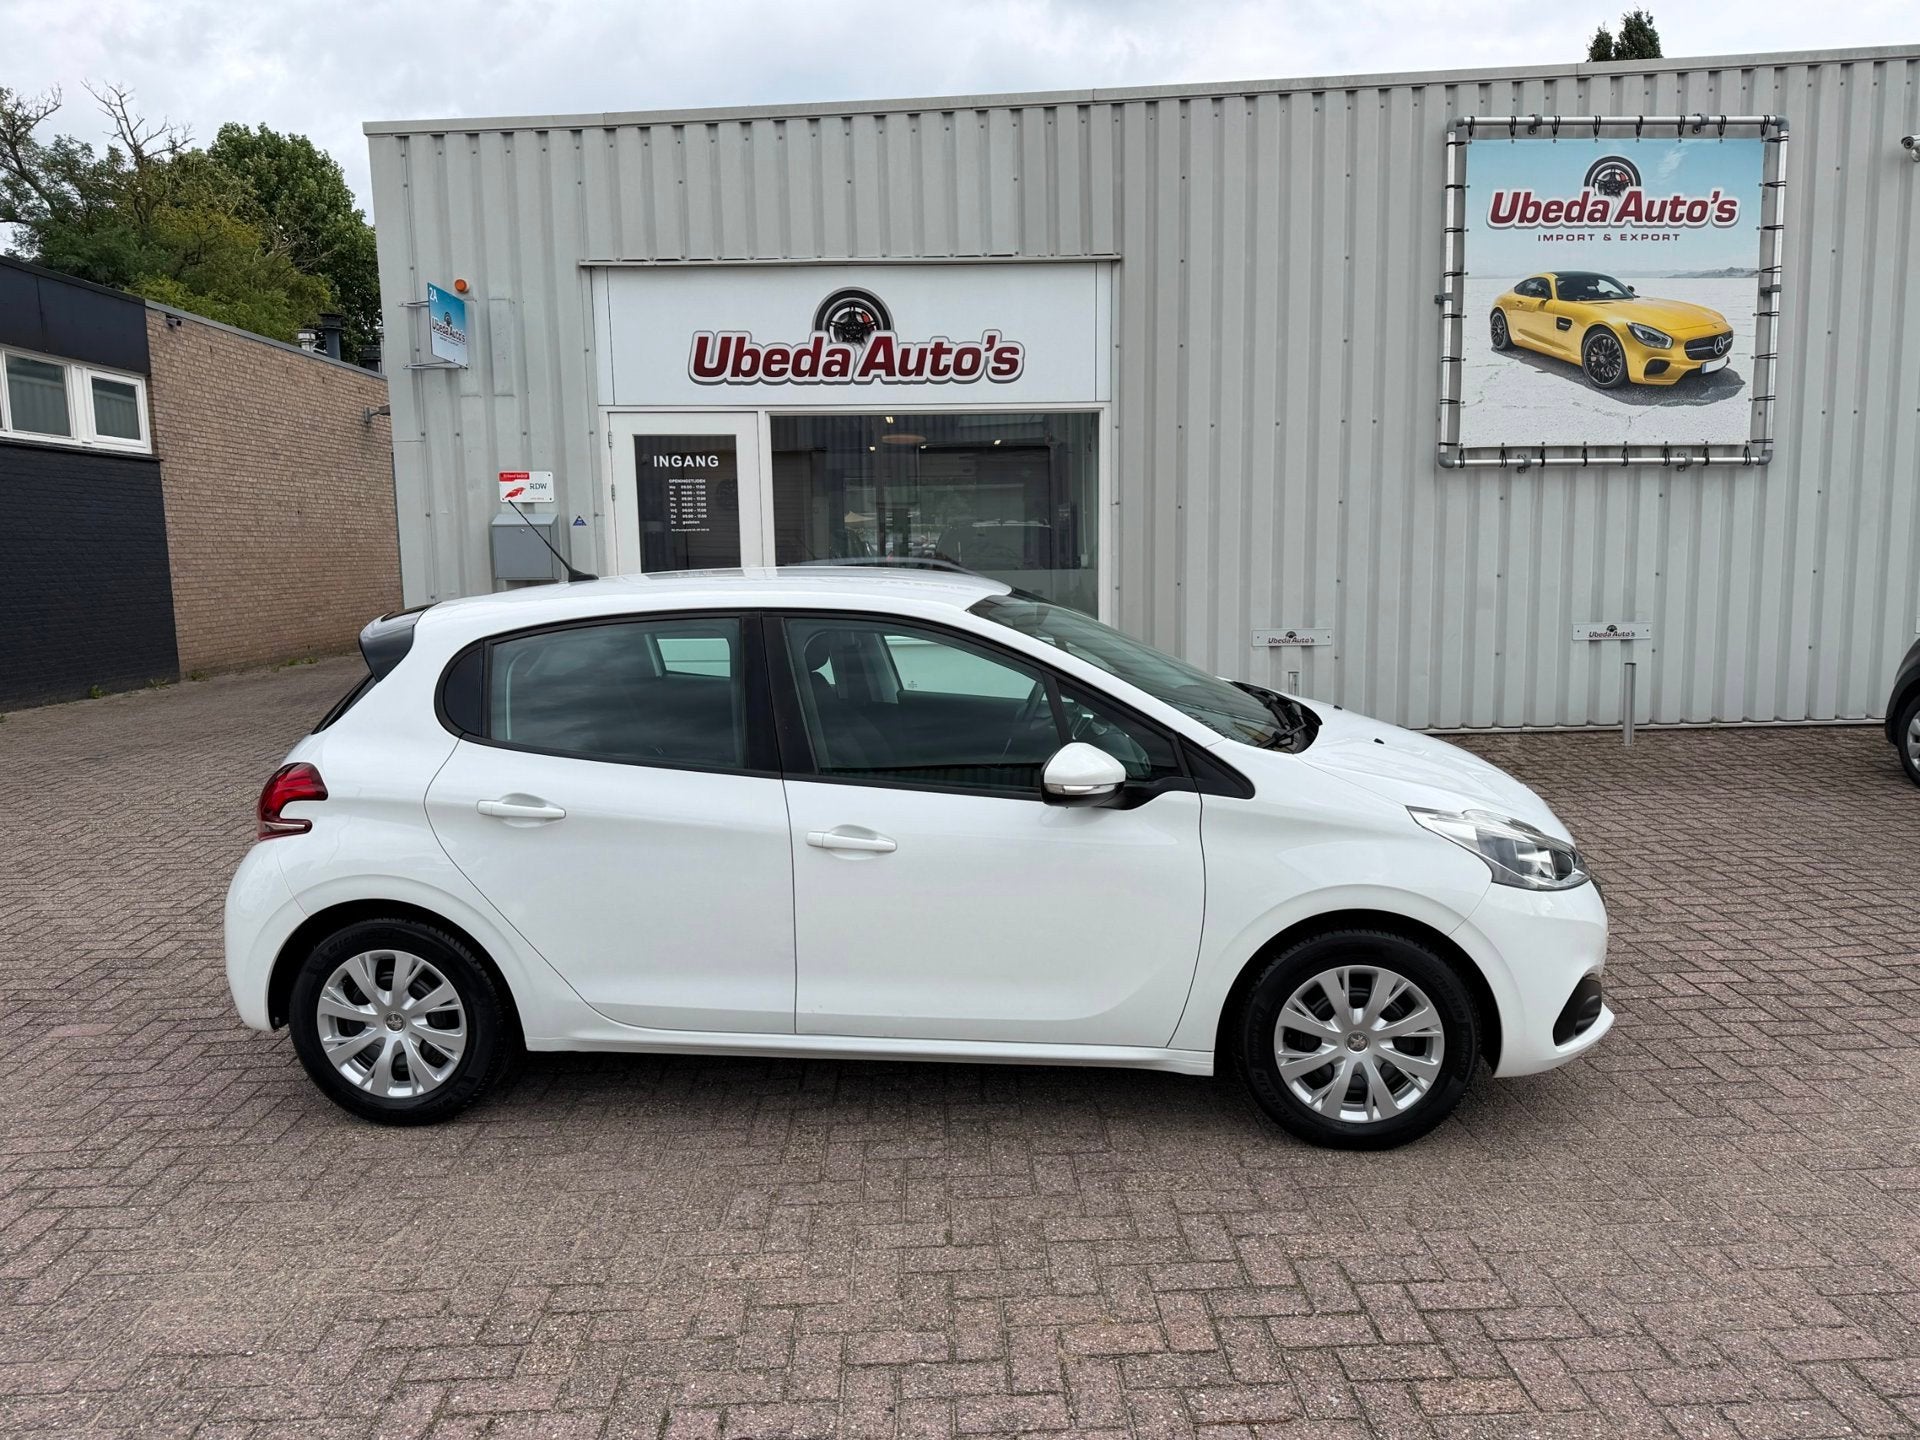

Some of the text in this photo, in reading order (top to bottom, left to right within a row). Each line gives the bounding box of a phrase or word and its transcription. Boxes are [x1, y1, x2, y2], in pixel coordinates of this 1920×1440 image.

[1489, 189, 1739, 225] Ubeda Auto's
[1537, 233, 1681, 242] IMPORT & EXPORT
[428, 286, 439, 303] 2A
[692, 333, 1021, 379] Ubeda Auto's
[653, 455, 719, 468] INGANG
[529, 482, 548, 490] RDW
